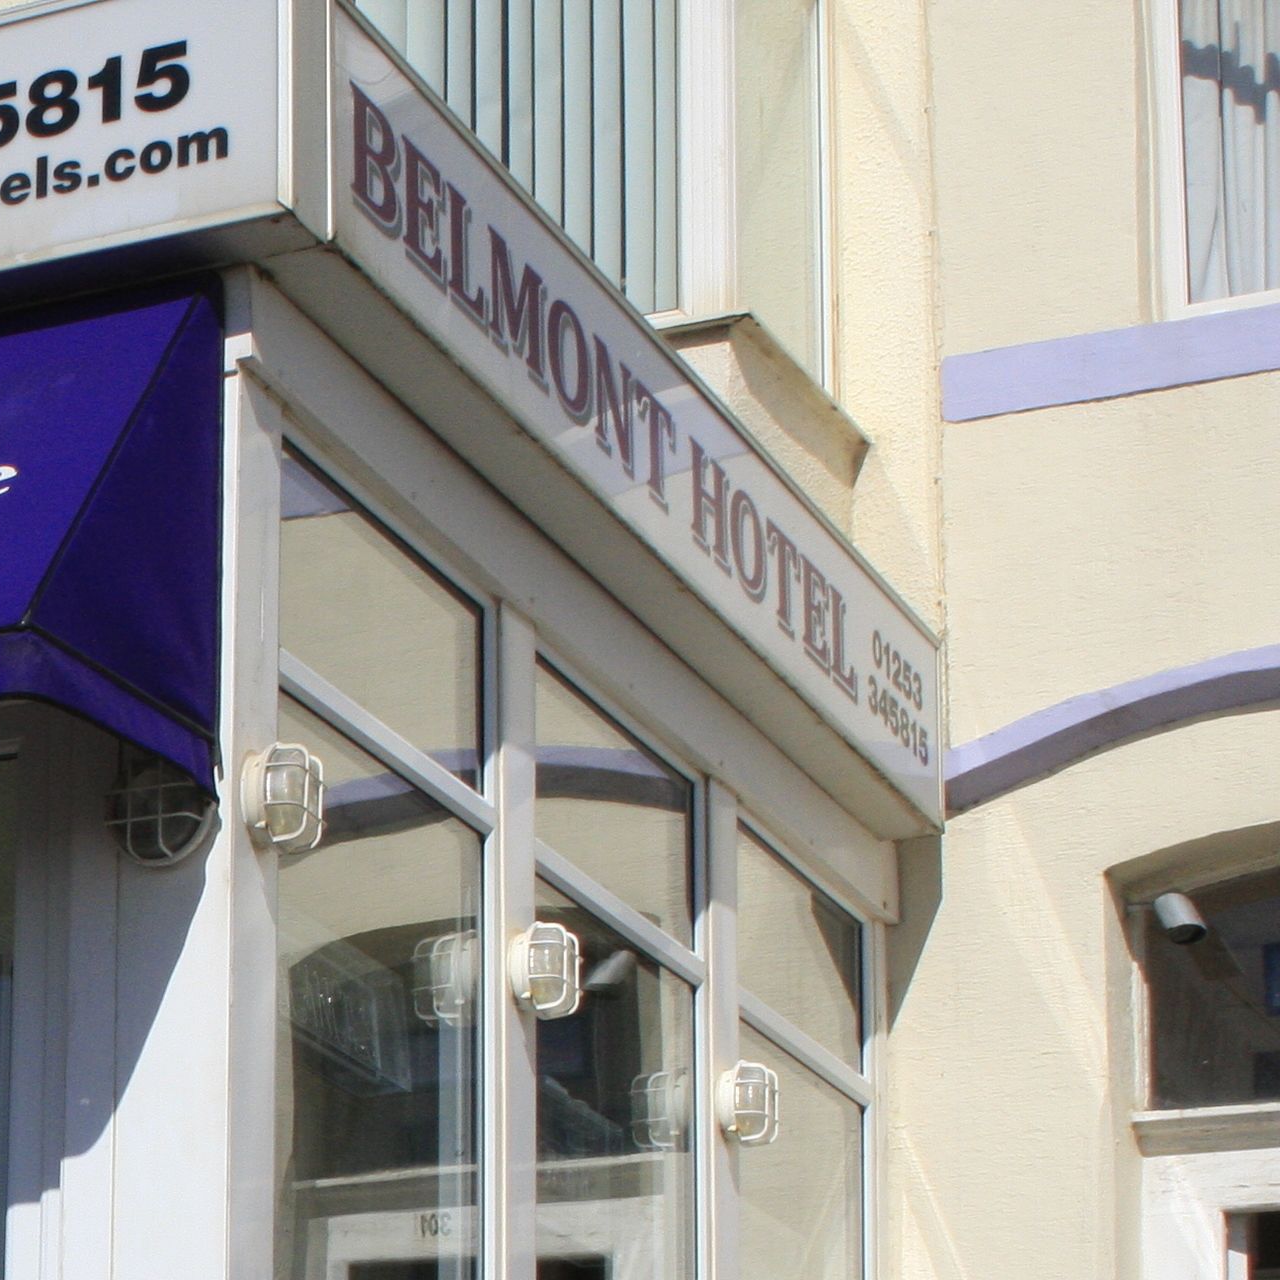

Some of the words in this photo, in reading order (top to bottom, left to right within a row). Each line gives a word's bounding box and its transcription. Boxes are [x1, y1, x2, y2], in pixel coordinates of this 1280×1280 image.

[348, 80, 677, 515] BELMONT
[688, 435, 859, 706] HOTEL
[872, 629, 923, 712] 01253
[868, 674, 929, 767] 345815
